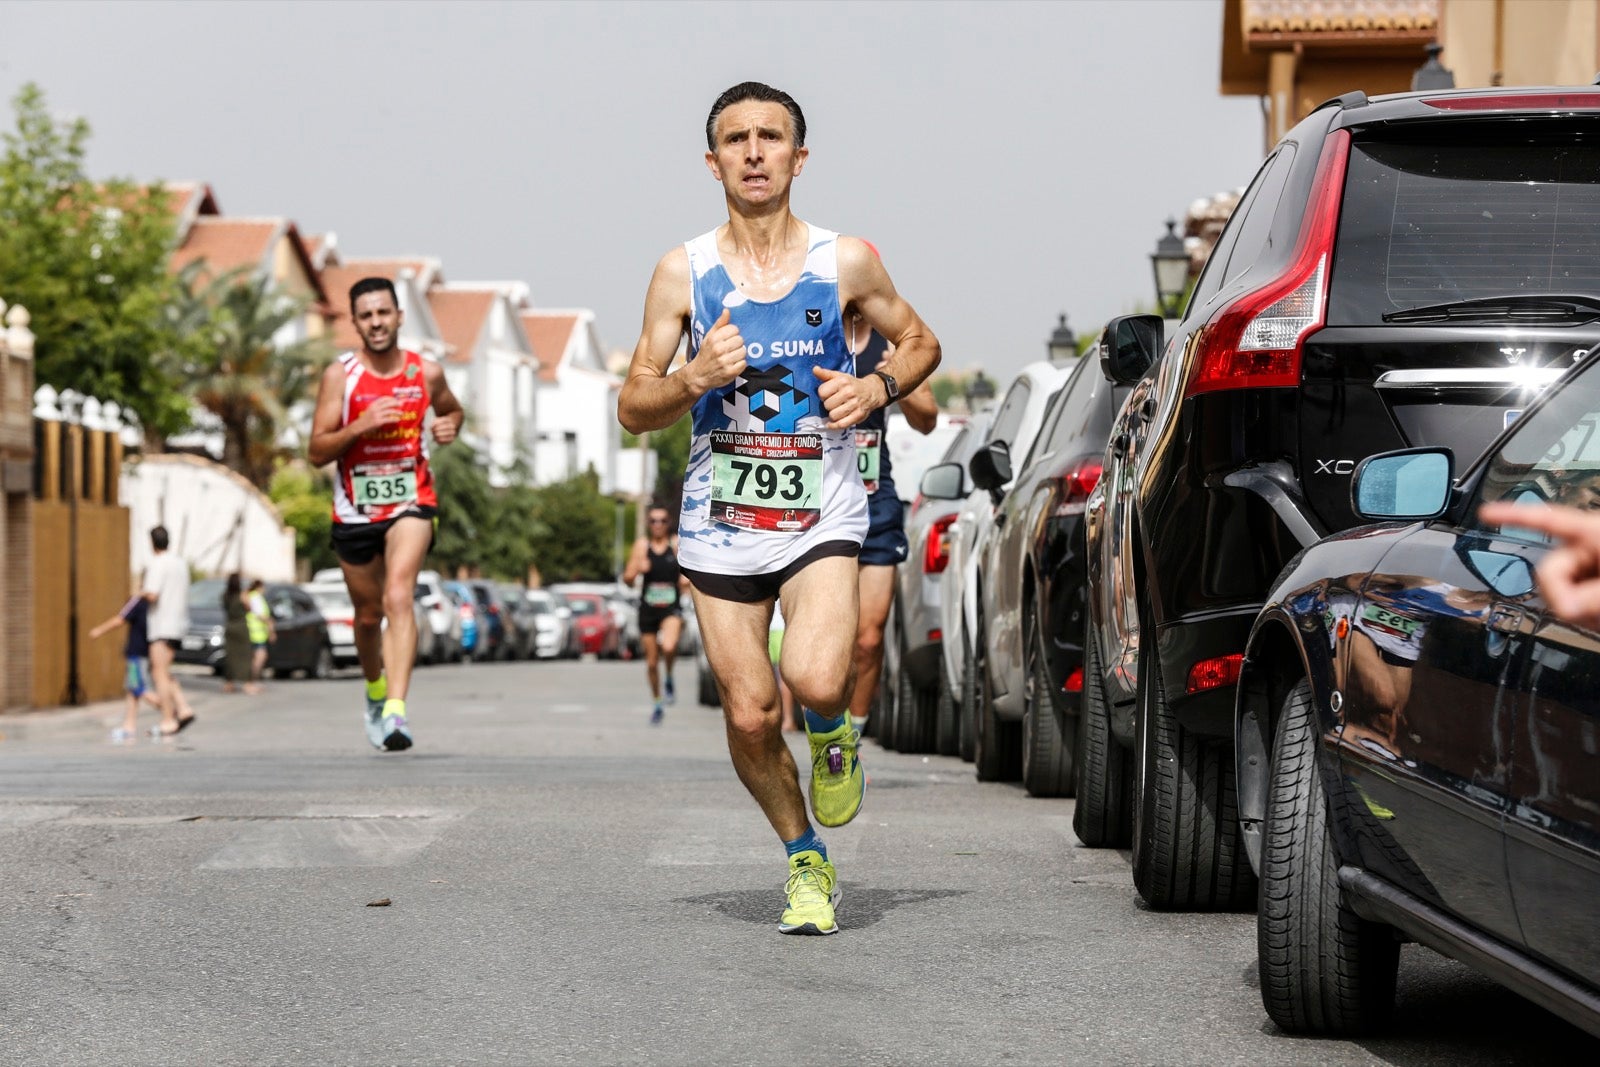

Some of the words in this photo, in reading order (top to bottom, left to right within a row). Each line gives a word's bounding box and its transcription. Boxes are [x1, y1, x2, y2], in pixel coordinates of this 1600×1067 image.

[770, 339, 825, 358] SUMA
[715, 433, 734, 443] XXXII
[735, 434, 754, 446] GRAN
[755, 436, 782, 447] PREMIO
[783, 436, 792, 447] DE
[793, 436, 817, 448] FONDO
[767, 449, 798, 458] CRUZCAMPO
[1314, 459, 1354, 475] XC
[366, 478, 406, 499] 635
[730, 460, 804, 501] 793
